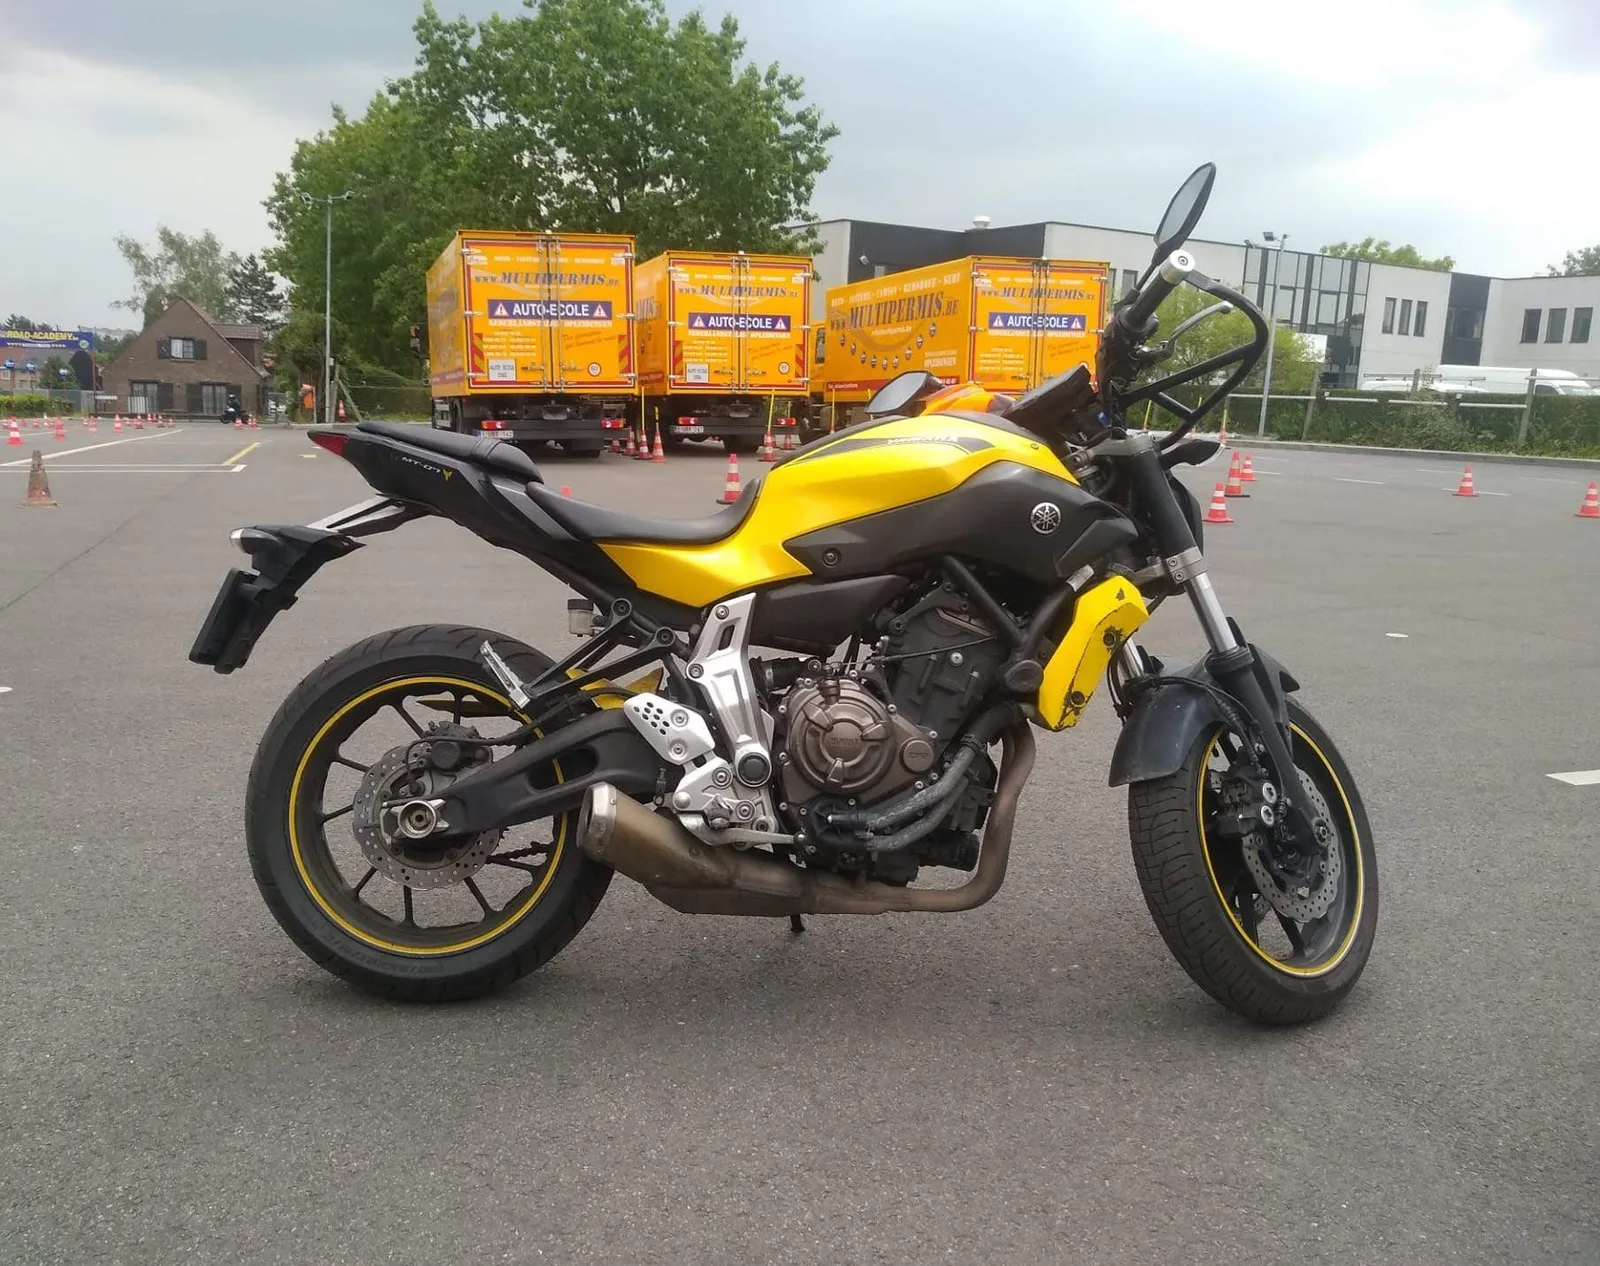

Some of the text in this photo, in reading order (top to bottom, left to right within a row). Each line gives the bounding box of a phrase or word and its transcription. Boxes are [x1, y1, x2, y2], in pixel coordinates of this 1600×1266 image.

[512, 303, 590, 316] AUTO-ECOLE
[708, 316, 773, 329] AUTO-ECOLE
[1007, 315, 1069, 328] AUTO-ECOLE
[401, 456, 441, 473] MT-07
